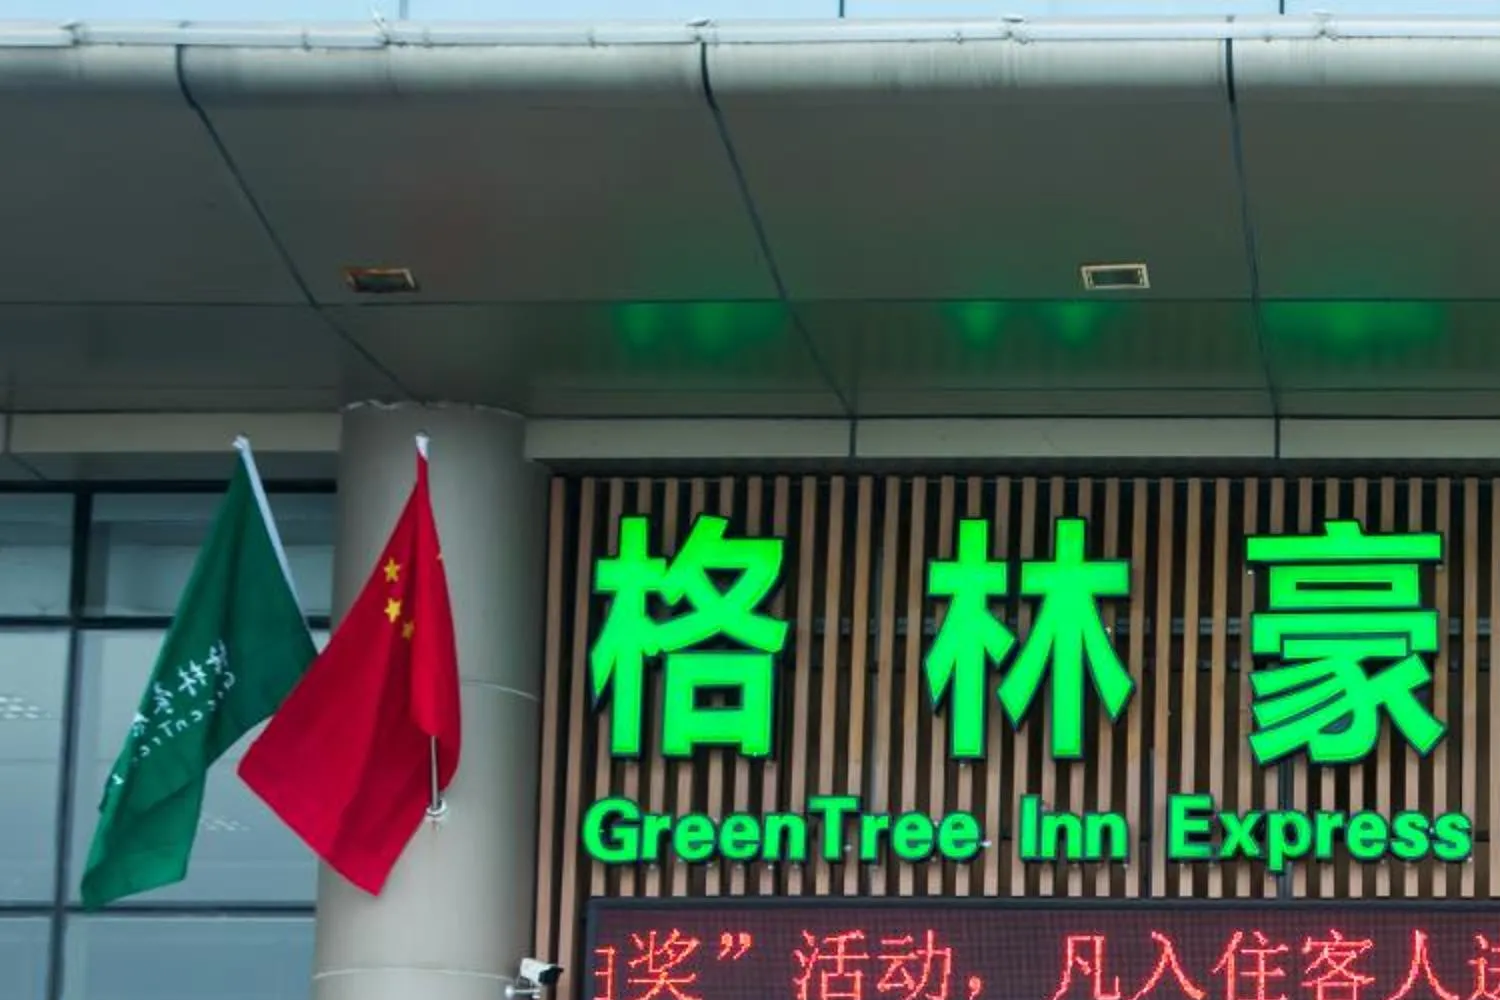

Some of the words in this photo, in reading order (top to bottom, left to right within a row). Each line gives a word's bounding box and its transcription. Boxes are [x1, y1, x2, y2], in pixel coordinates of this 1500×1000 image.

[582, 796, 981, 863] GreenTree
[1019, 796, 1128, 860] Inn
[1168, 794, 1473, 873] Express
